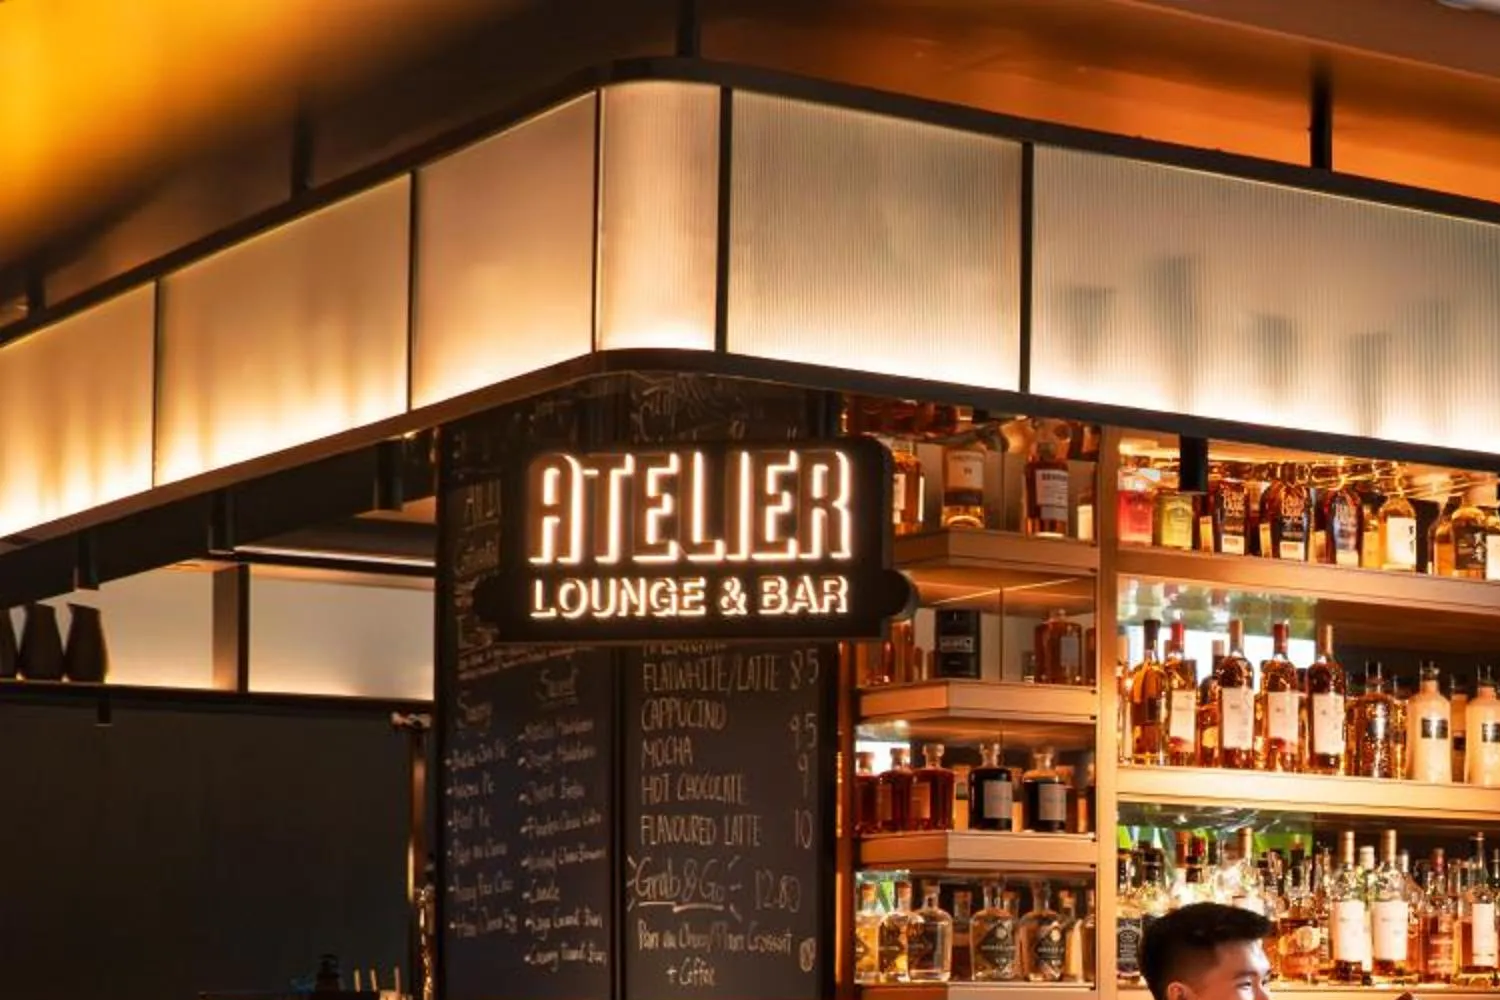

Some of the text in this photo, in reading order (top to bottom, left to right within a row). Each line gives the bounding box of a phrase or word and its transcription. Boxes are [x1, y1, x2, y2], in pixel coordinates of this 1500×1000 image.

[528, 449, 853, 564] ATELIER
[530, 574, 849, 619] LOUNGE & BAR
[641, 735, 694, 770] MOCHA
[641, 772, 670, 806] HOT
[641, 807, 813, 850] FLAVOURED LATTE 10
[635, 856, 681, 898] Grab
[700, 858, 725, 901] Go
